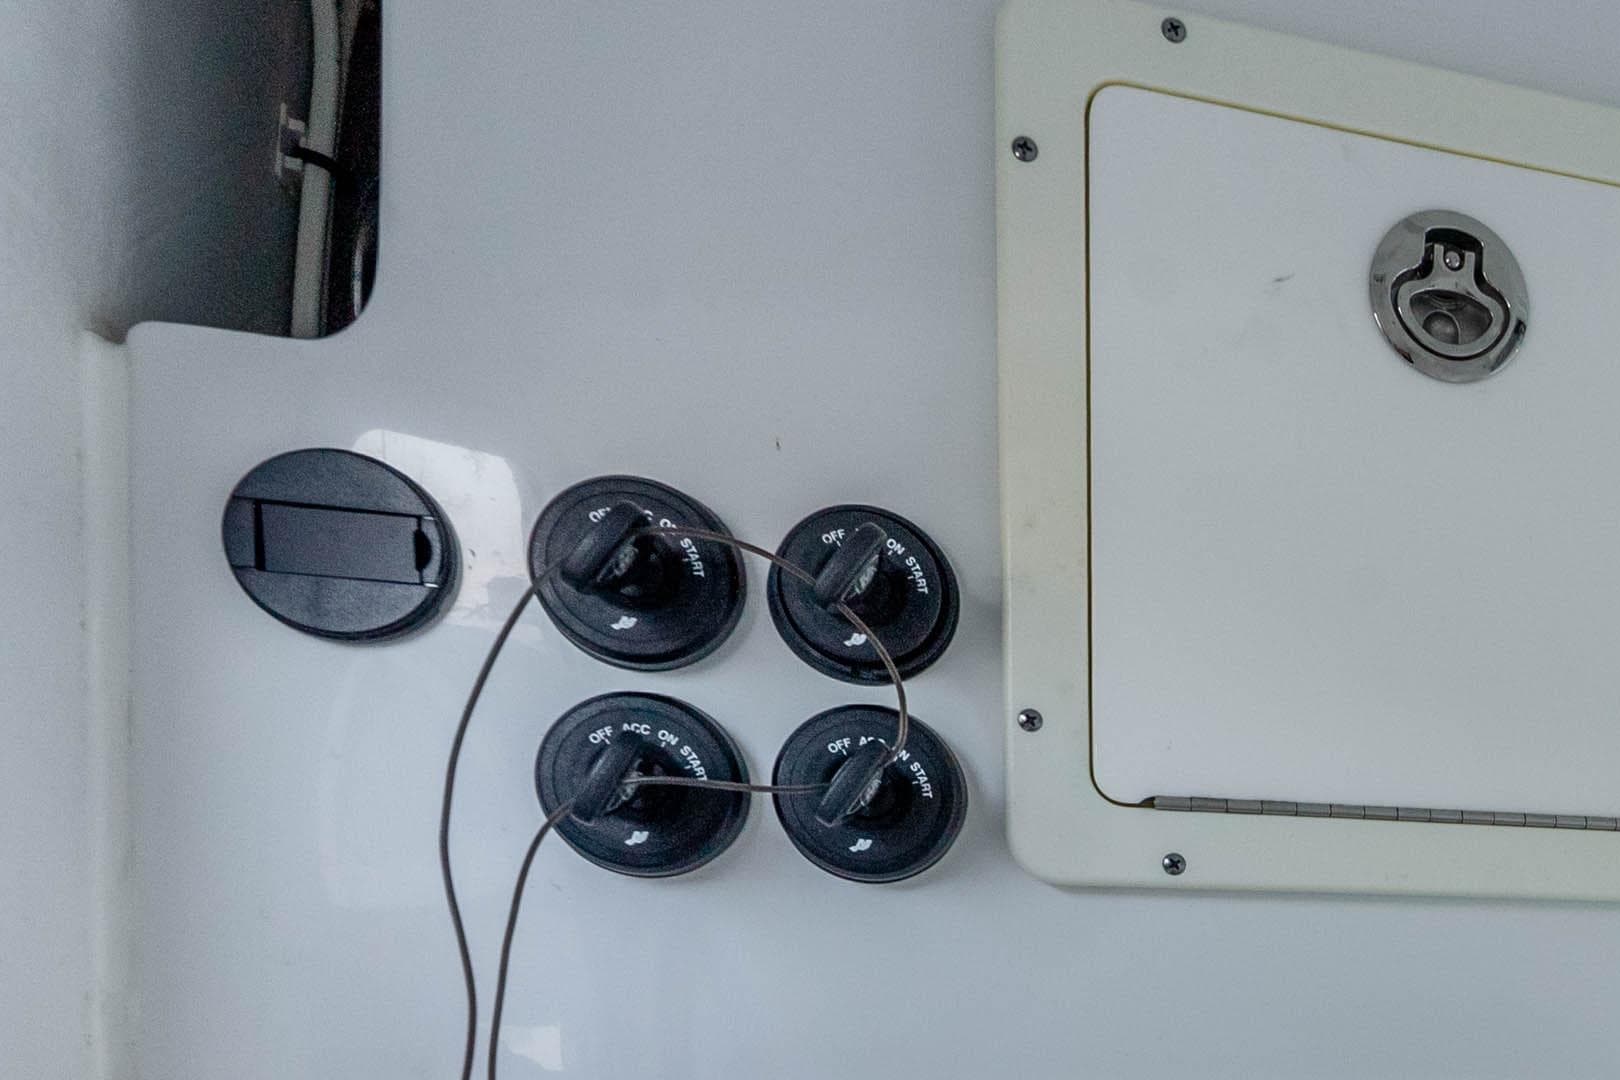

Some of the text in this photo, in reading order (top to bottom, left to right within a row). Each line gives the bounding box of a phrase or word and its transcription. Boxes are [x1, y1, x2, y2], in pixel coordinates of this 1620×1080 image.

[680, 537, 705, 578] START
[822, 528, 928, 595] OFF ON START
[589, 725, 613, 744] OFF
[657, 729, 679, 745] ON
[680, 745, 708, 781] START
[827, 737, 851, 753] OFF
[910, 762, 933, 798] START
